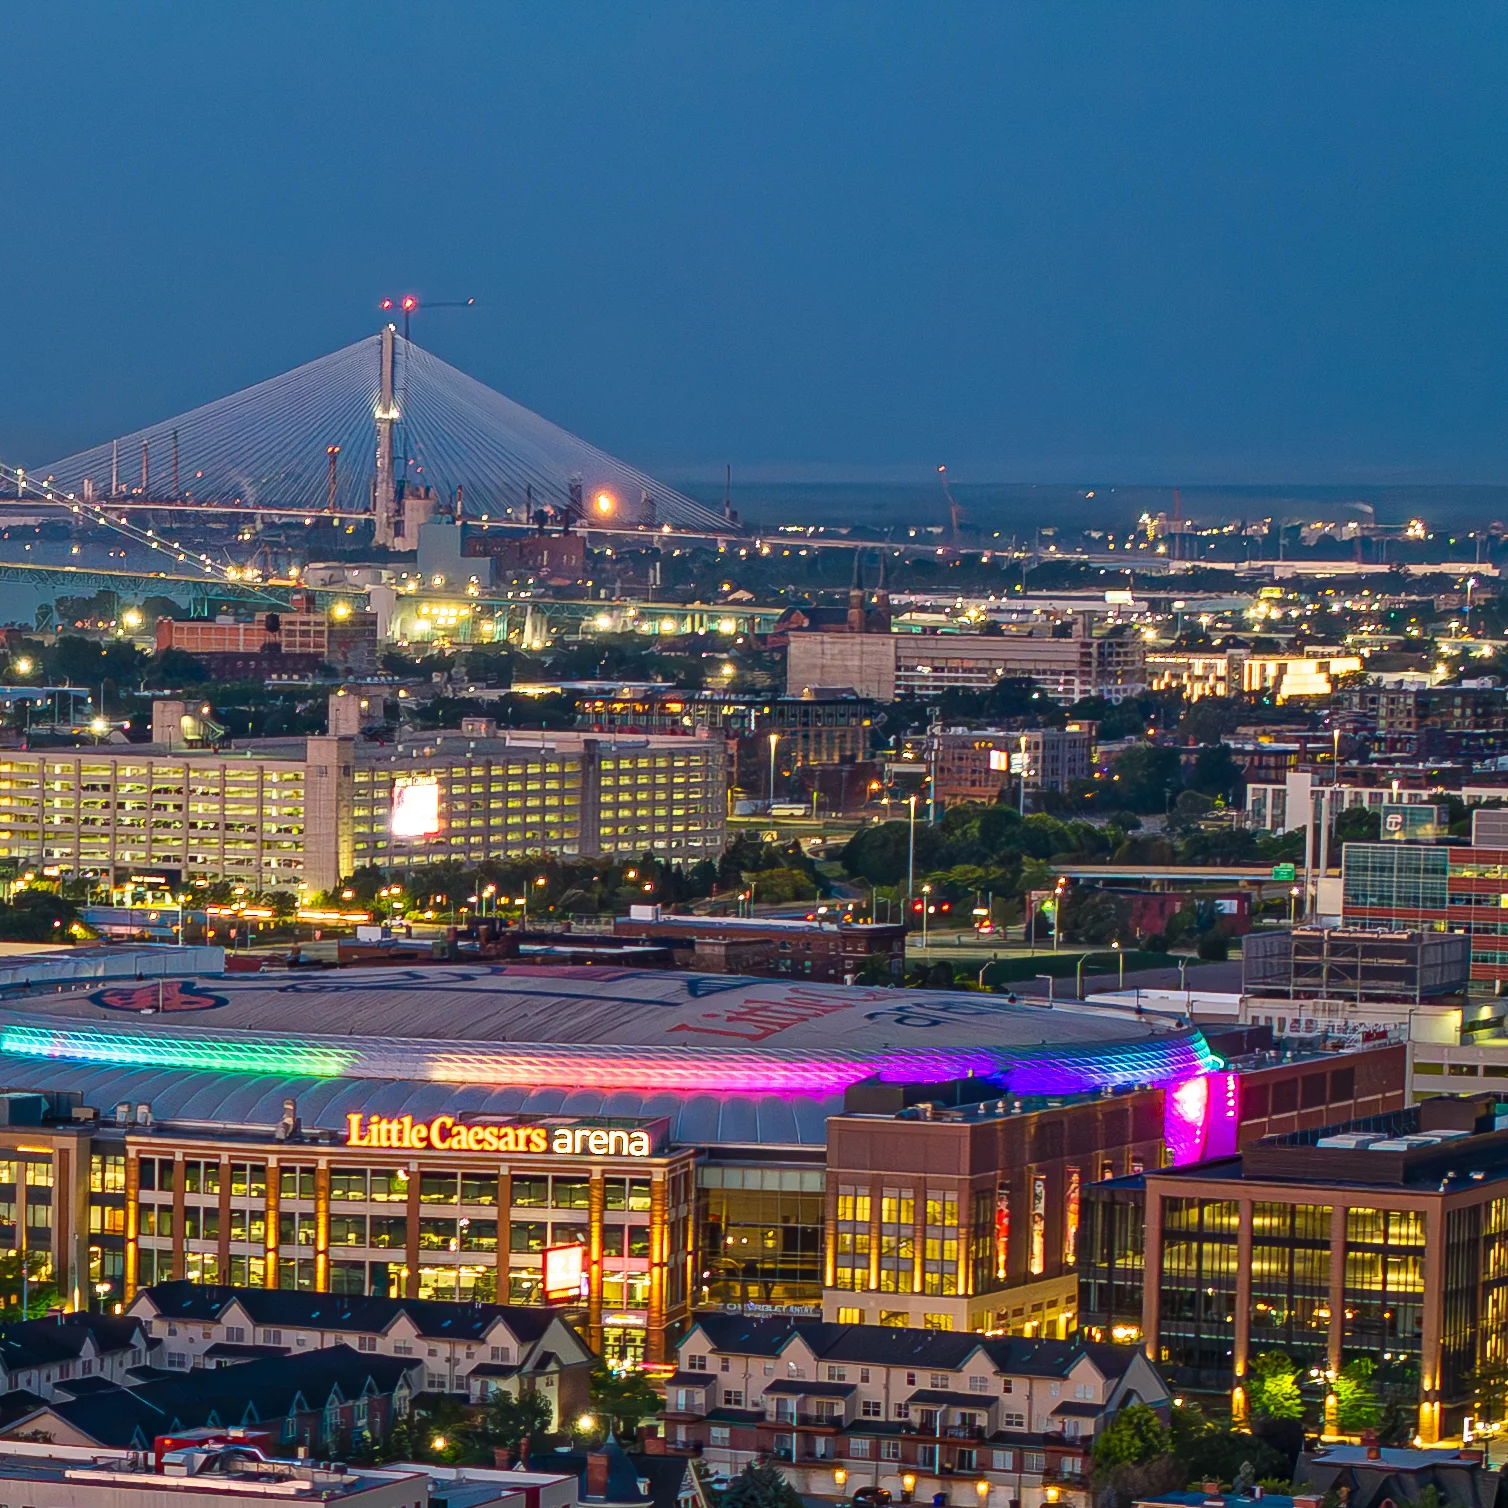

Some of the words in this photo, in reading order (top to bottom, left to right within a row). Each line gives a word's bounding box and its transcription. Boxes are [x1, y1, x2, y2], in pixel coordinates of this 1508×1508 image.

[347, 1113, 428, 1147] Little
[429, 1115, 547, 1152] Caesars
[552, 1127, 649, 1156] arena
